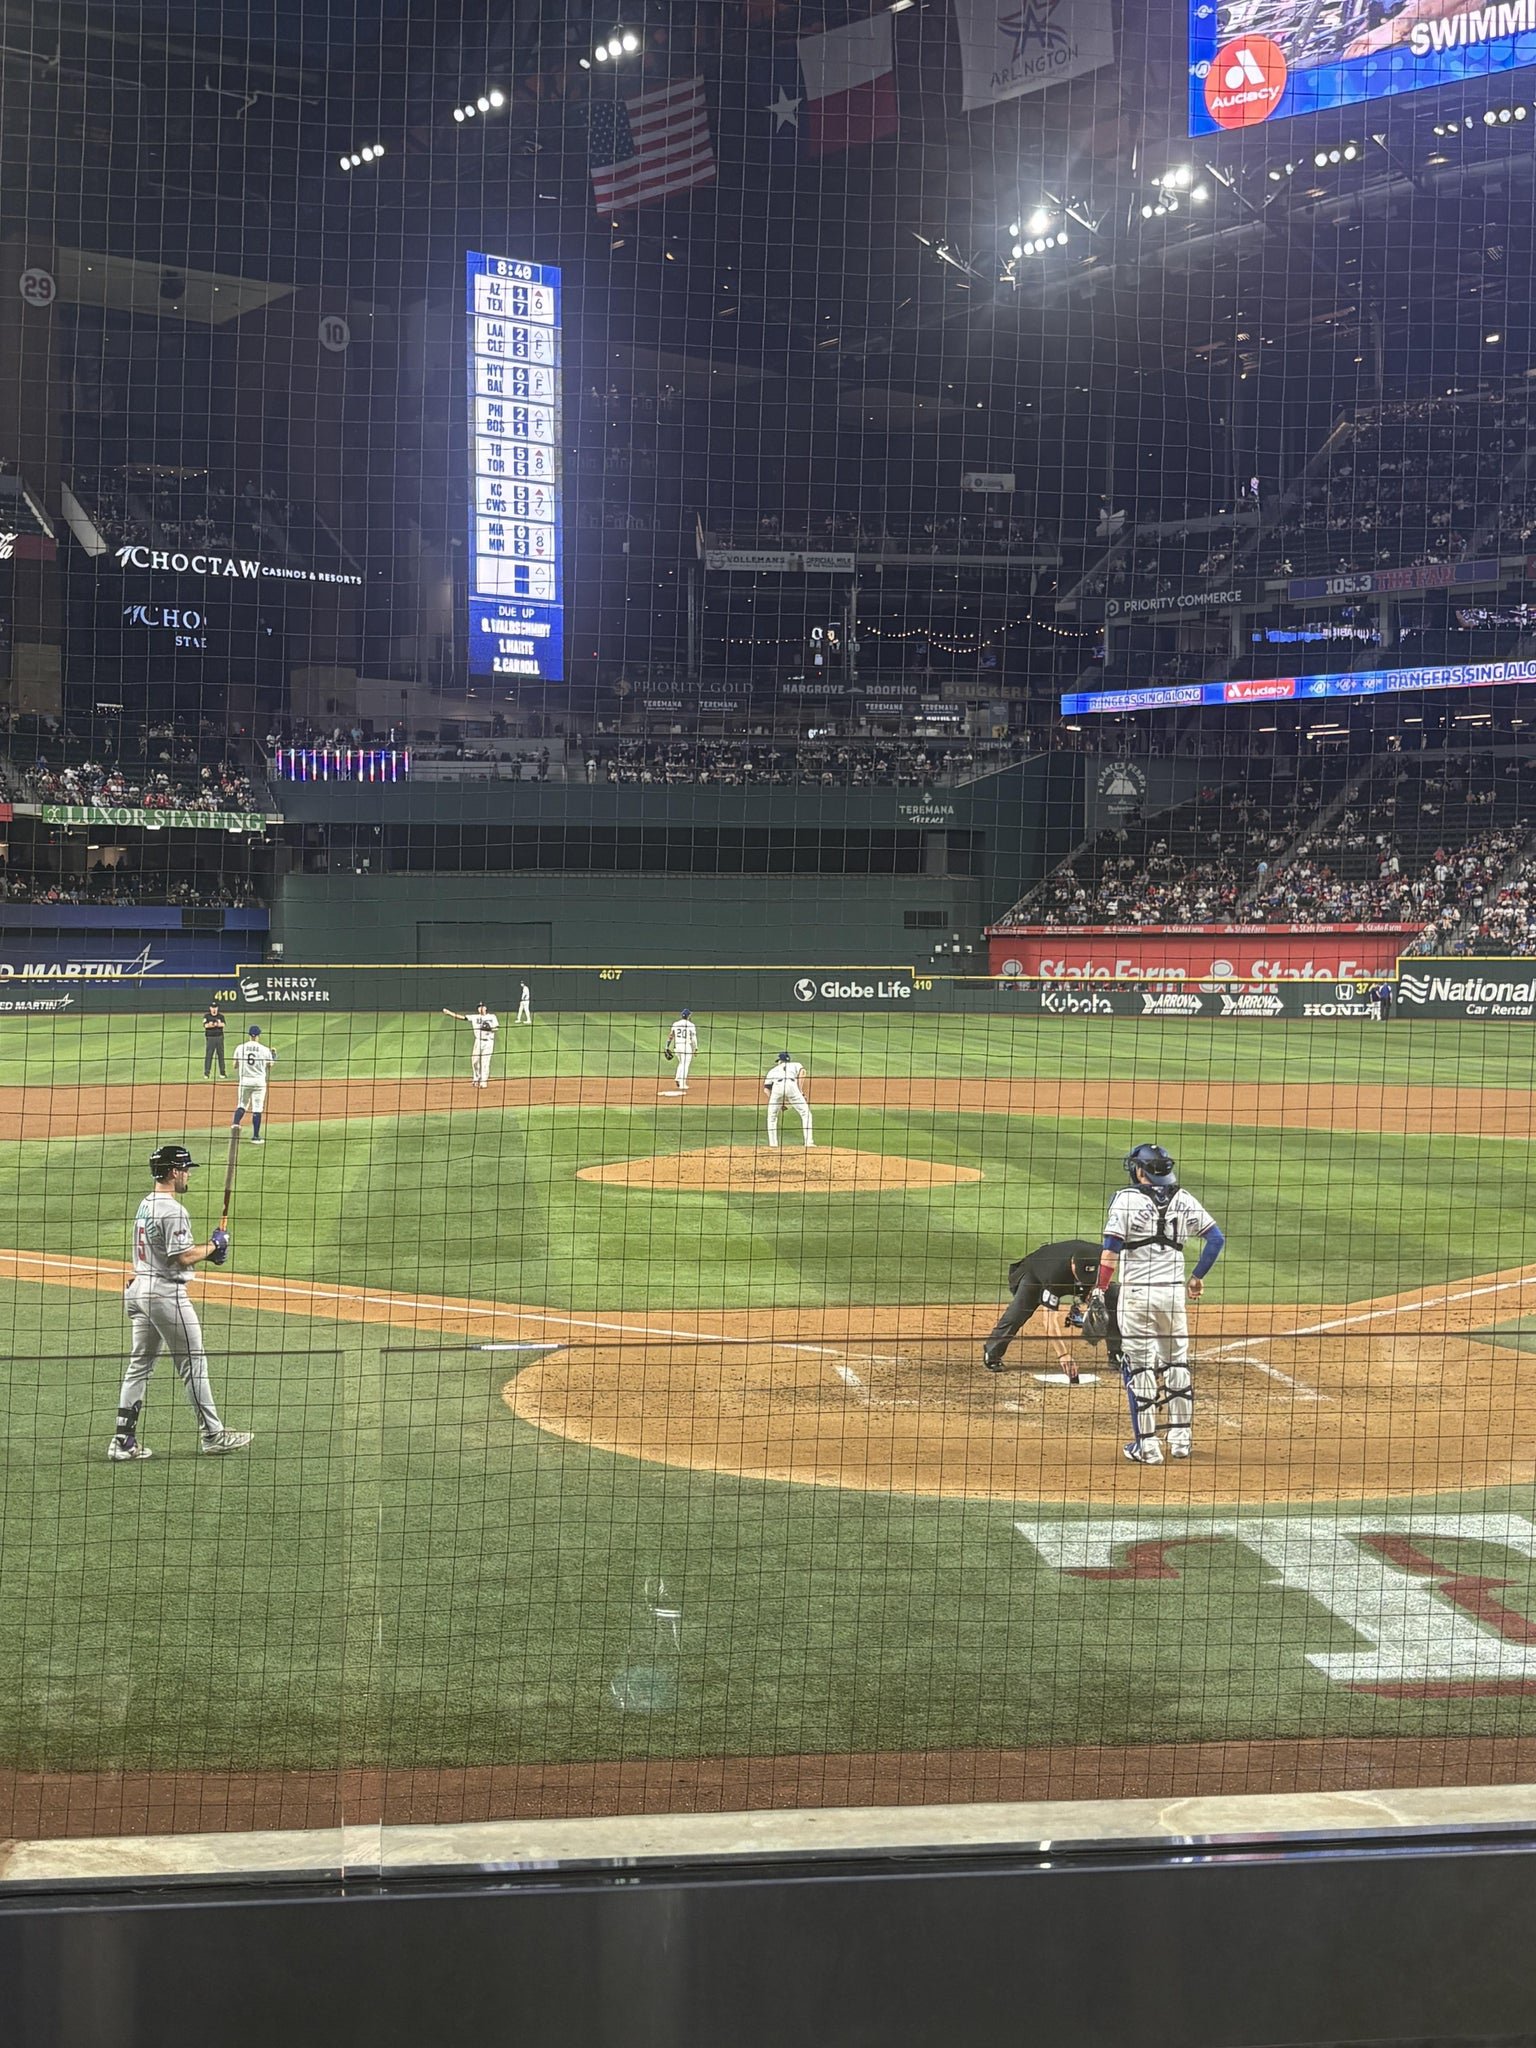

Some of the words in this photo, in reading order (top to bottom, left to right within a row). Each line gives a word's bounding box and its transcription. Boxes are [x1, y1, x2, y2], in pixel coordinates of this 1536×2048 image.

[990, 44, 1079, 88] ARLNGTON
[1211, 85, 1280, 110] Audacy
[497, 261, 532, 280] 8:40
[24, 276, 50, 299] 29
[490, 282, 500, 296] AZ
[517, 289, 524, 299] 1
[487, 297, 503, 312] TEX
[517, 304, 525, 315] 7
[535, 299, 543, 309] 6
[325, 323, 343, 344] 10
[487, 323, 503, 337] LAA
[516, 328, 525, 340] 2
[488, 338, 503, 352] CLE
[516, 344, 525, 355] 3
[536, 340, 542, 350] F
[487, 363, 503, 378] NYY
[516, 369, 525, 380] 6
[487, 379, 503, 393] BAL
[516, 384, 525, 396] 2
[536, 379, 542, 390] F
[488, 403, 503, 417] PHI
[516, 408, 525, 420] 2
[487, 419, 504, 433] BOS
[517, 424, 525, 435] 1
[536, 419, 542, 429] F
[490, 443, 501, 457] TB
[517, 449, 525, 460] 5
[487, 459, 504, 472] TOR
[517, 464, 525, 475] 5
[536, 458, 543, 469] 8
[491, 483, 502, 497] KC
[517, 488, 525, 499] 5
[486, 498, 506, 512] CWS
[517, 503, 525, 514] 5
[536, 497, 543, 508] 7
[489, 523, 504, 536] MIA
[517, 526, 525, 538] 0
[489, 538, 504, 551] MIN
[517, 542, 525, 553] 3
[536, 536, 543, 547] 8
[131, 546, 260, 579] CHOCTAW
[262, 567, 306, 579] CASINOS
[309, 571, 316, 580] &
[318, 572, 362, 585] RESORTS
[1326, 575, 1371, 595] 105.3
[1374, 570, 1412, 591] THE
[1416, 565, 1456, 587] FAN
[1124, 597, 1175, 612] PRIORITY
[1177, 590, 1242, 607] COMMERCE
[499, 606, 517, 617] DUE
[522, 608, 535, 618] UP
[1387, 667, 1462, 689] RANGERS
[1464, 662, 1504, 683] SING
[633, 681, 704, 692] PRIORITY
[710, 682, 754, 693] GOLD
[782, 684, 844, 695] HARGROVE
[866, 685, 917, 695] ROOFING
[643, 700, 682, 708] TEREMANA
[1090, 694, 1137, 710] RANGERS
[1139, 692, 1163, 706] SING
[1165, 688, 1201, 703] ALONG
[1243, 683, 1290, 697] Audacy
[899, 805, 954, 815] TEREMANA
[67, 807, 147, 826] LUXOR
[153, 809, 262, 830] STAFFING
[909, 815, 944, 824] TERRACE
[21, 964, 122, 983] MARTIN
[599, 970, 622, 980] 407
[1338, 960, 1394, 979] Far
[266, 977, 317, 988] ENERGY
[820, 981, 874, 998] Globe
[877, 981, 911, 998] Life
[913, 981, 932, 991] 410
[1429, 978, 1536, 1002] National
[214, 990, 237, 1001] 410
[267, 991, 330, 1001] TRANSFER
[1041, 992, 1114, 1014] Kubota
[1156, 995, 1196, 1008] ARROW
[1237, 996, 1275, 1009] ARROW
[15, 1001, 57, 1010] MARTIN
[1466, 1004, 1488, 1014] Car
[1491, 1004, 1533, 1015] Rental
[676, 1028, 687, 1039] 20
[247, 1052, 257, 1066] 6
